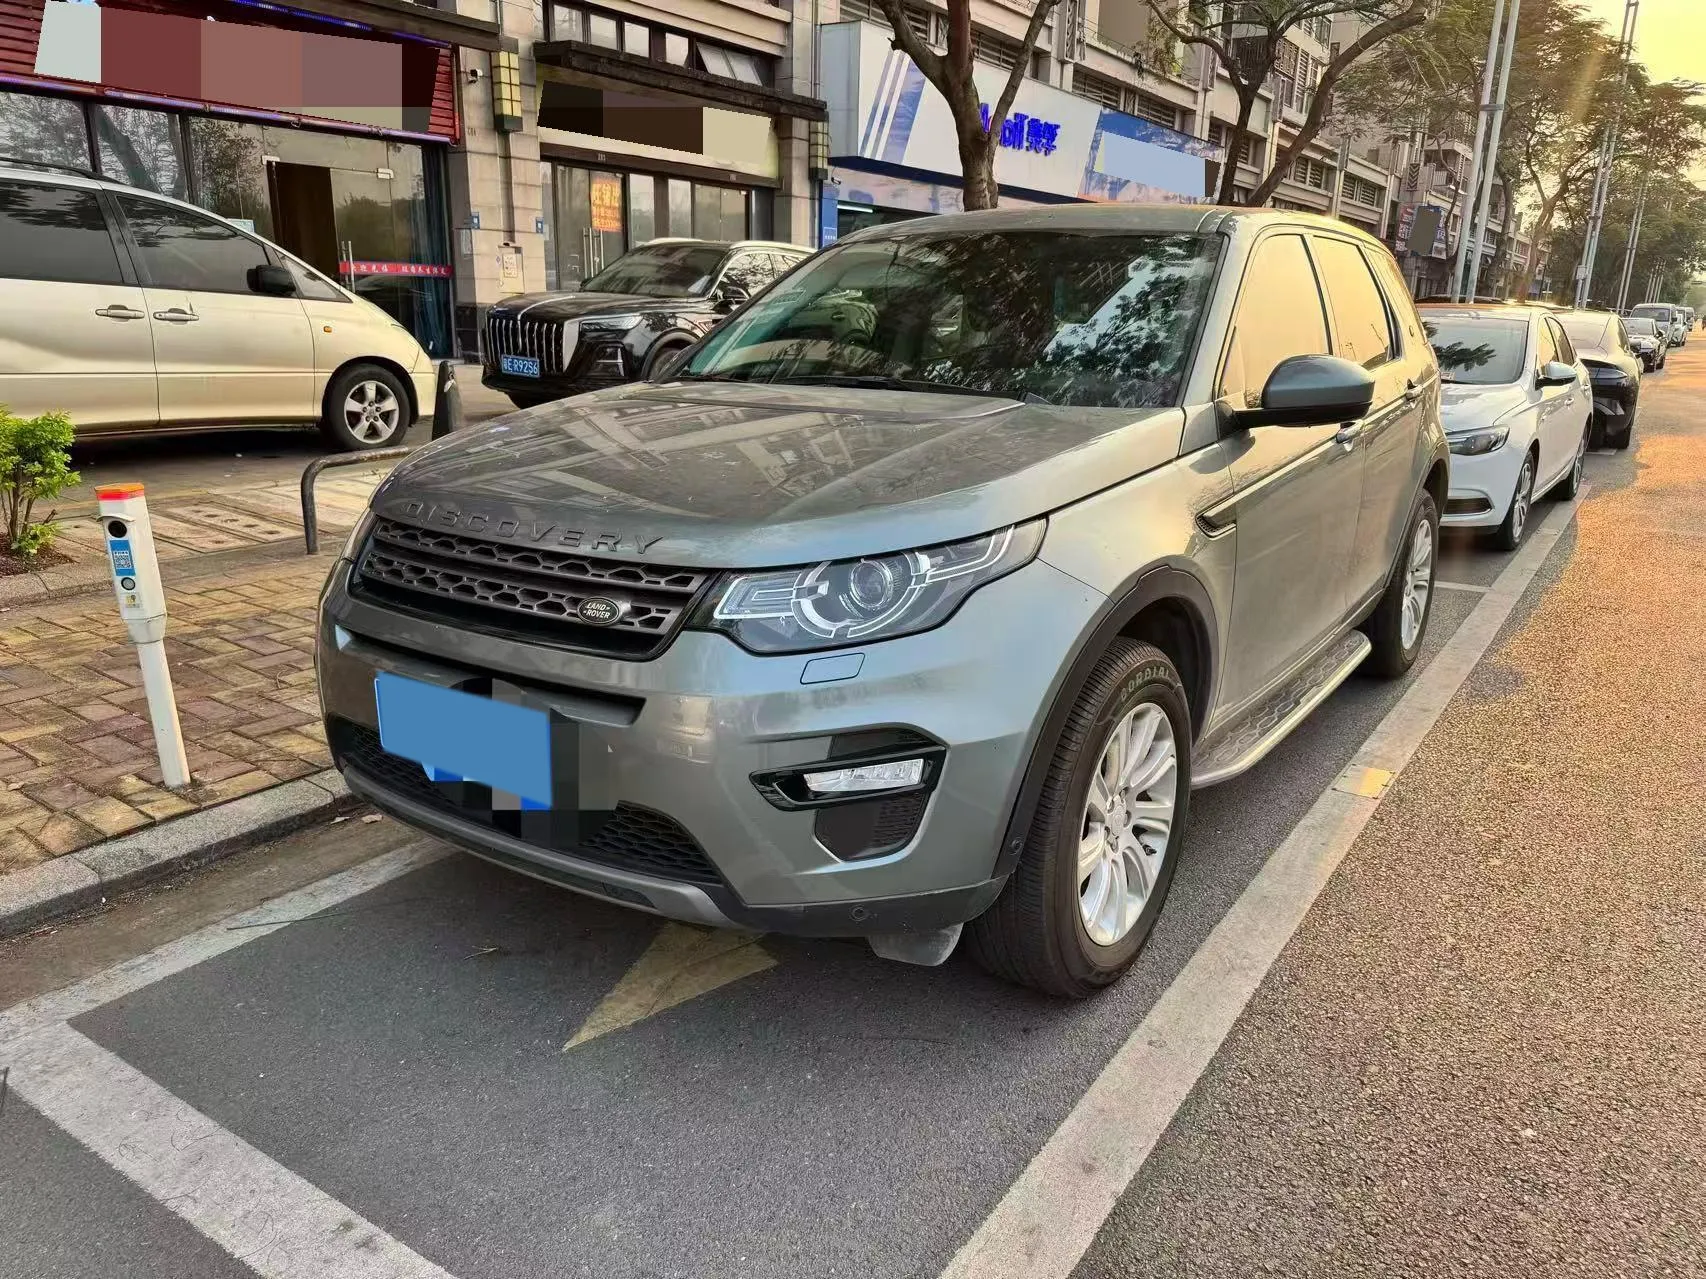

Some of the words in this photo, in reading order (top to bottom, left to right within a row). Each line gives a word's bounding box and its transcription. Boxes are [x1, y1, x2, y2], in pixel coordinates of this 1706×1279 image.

[403, 502, 664, 554] DISCOVERY
[586, 602, 607, 611] LAND
[585, 609, 611, 619] ROVER
